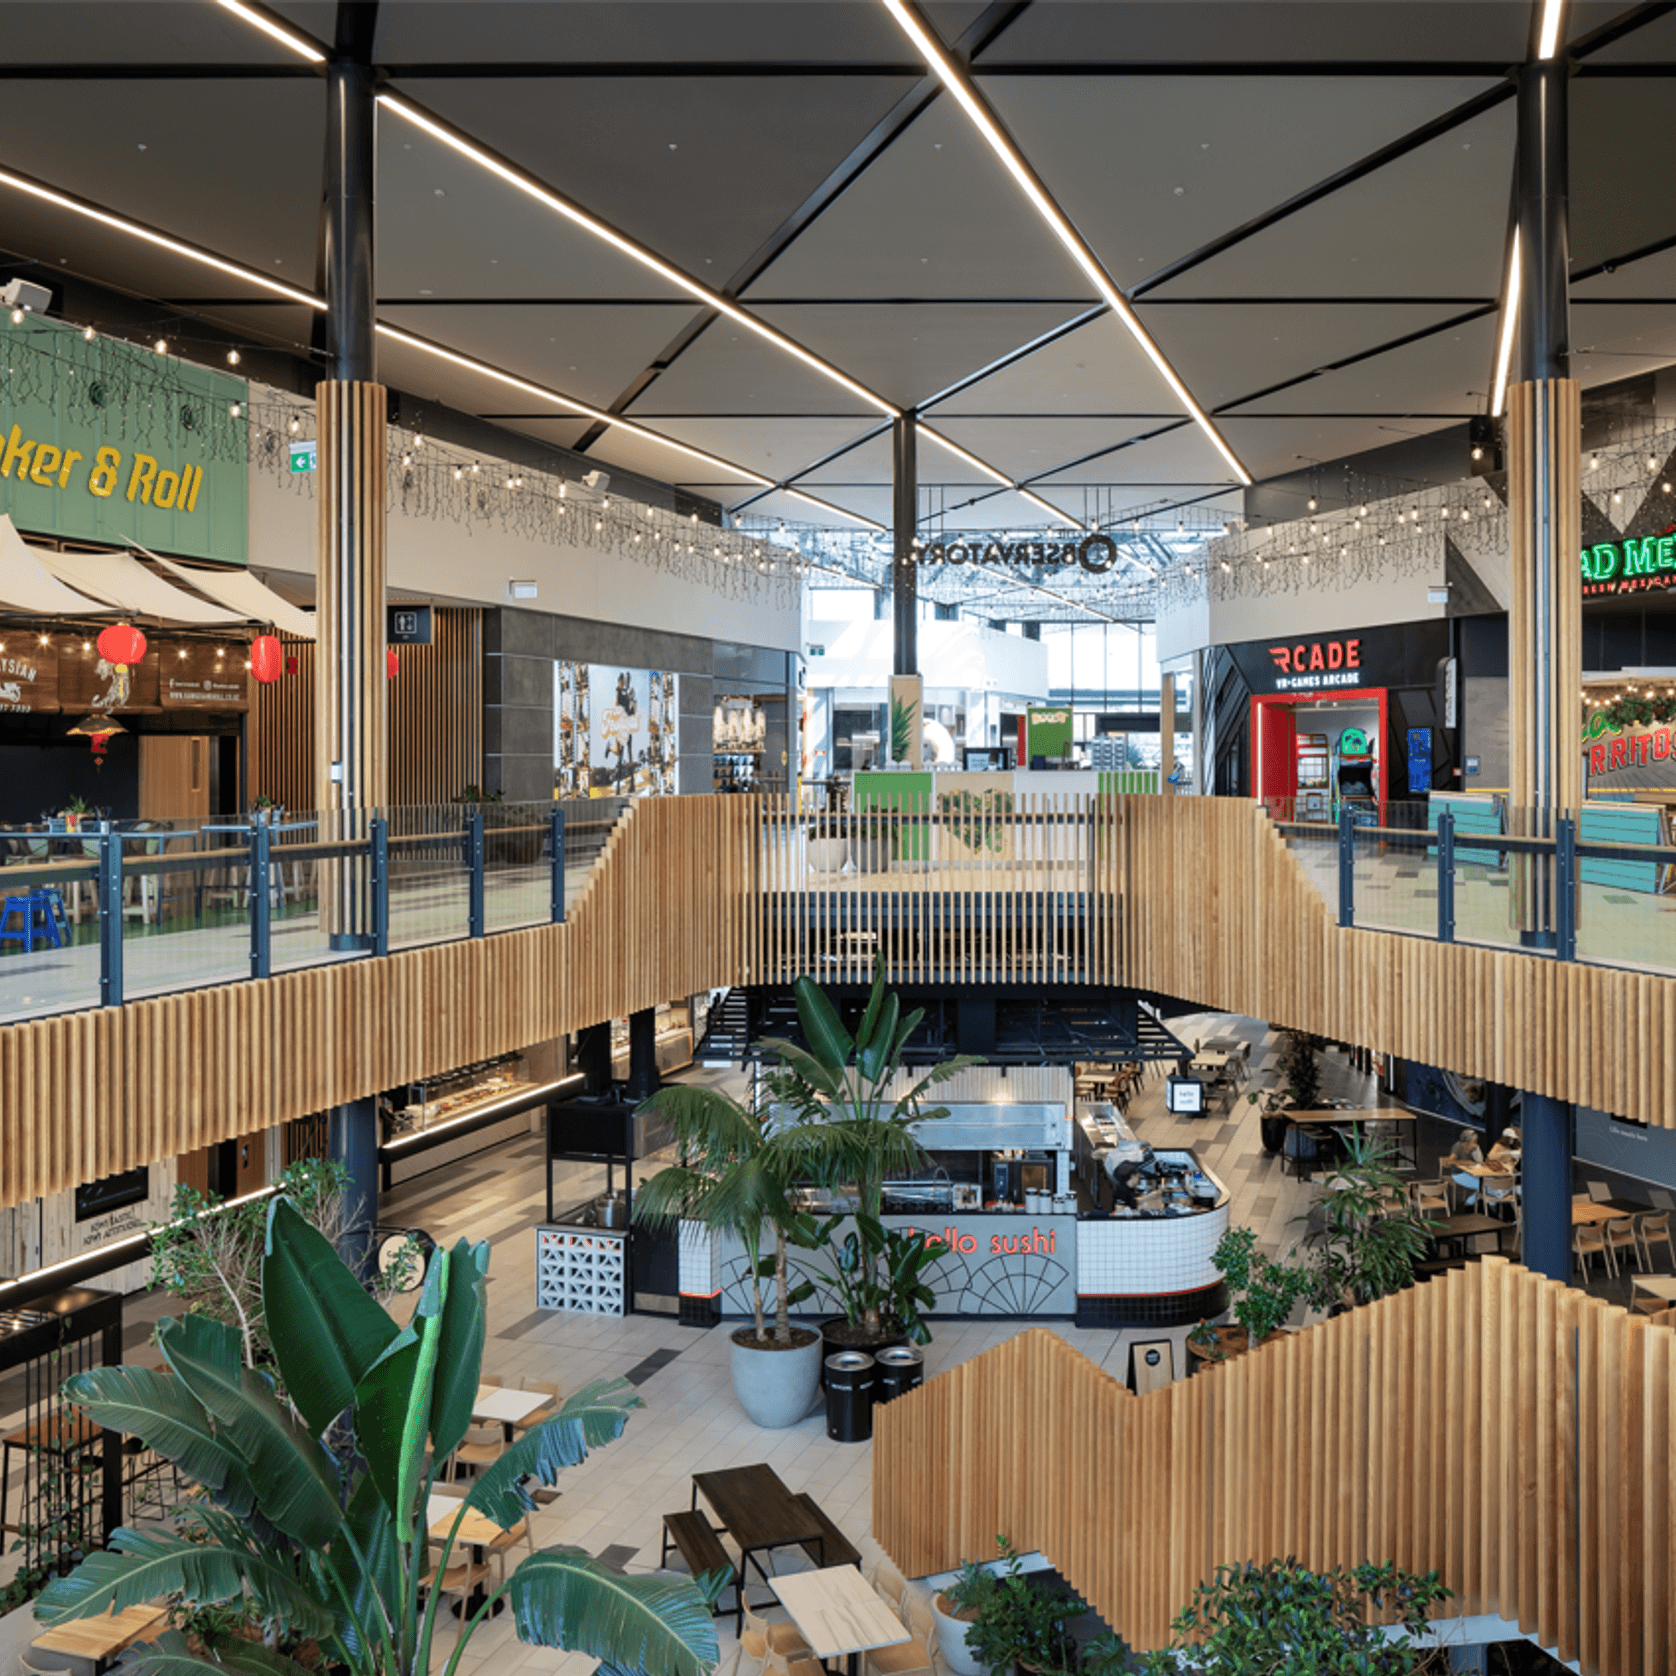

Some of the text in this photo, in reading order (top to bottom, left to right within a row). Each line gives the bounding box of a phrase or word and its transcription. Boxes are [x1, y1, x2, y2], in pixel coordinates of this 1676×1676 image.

[0, 423, 203, 513] ker & Roll
[1580, 535, 1676, 580] AD ME
[1582, 574, 1676, 595] RESH MEXICA
[0, 658, 37, 682] YSIAN
[1268, 639, 1360, 673] RCADE
[1322, 672, 1359, 686] ARCADE
[1589, 728, 1676, 778] RRITO
[989, 1226, 1056, 1255] sushi
